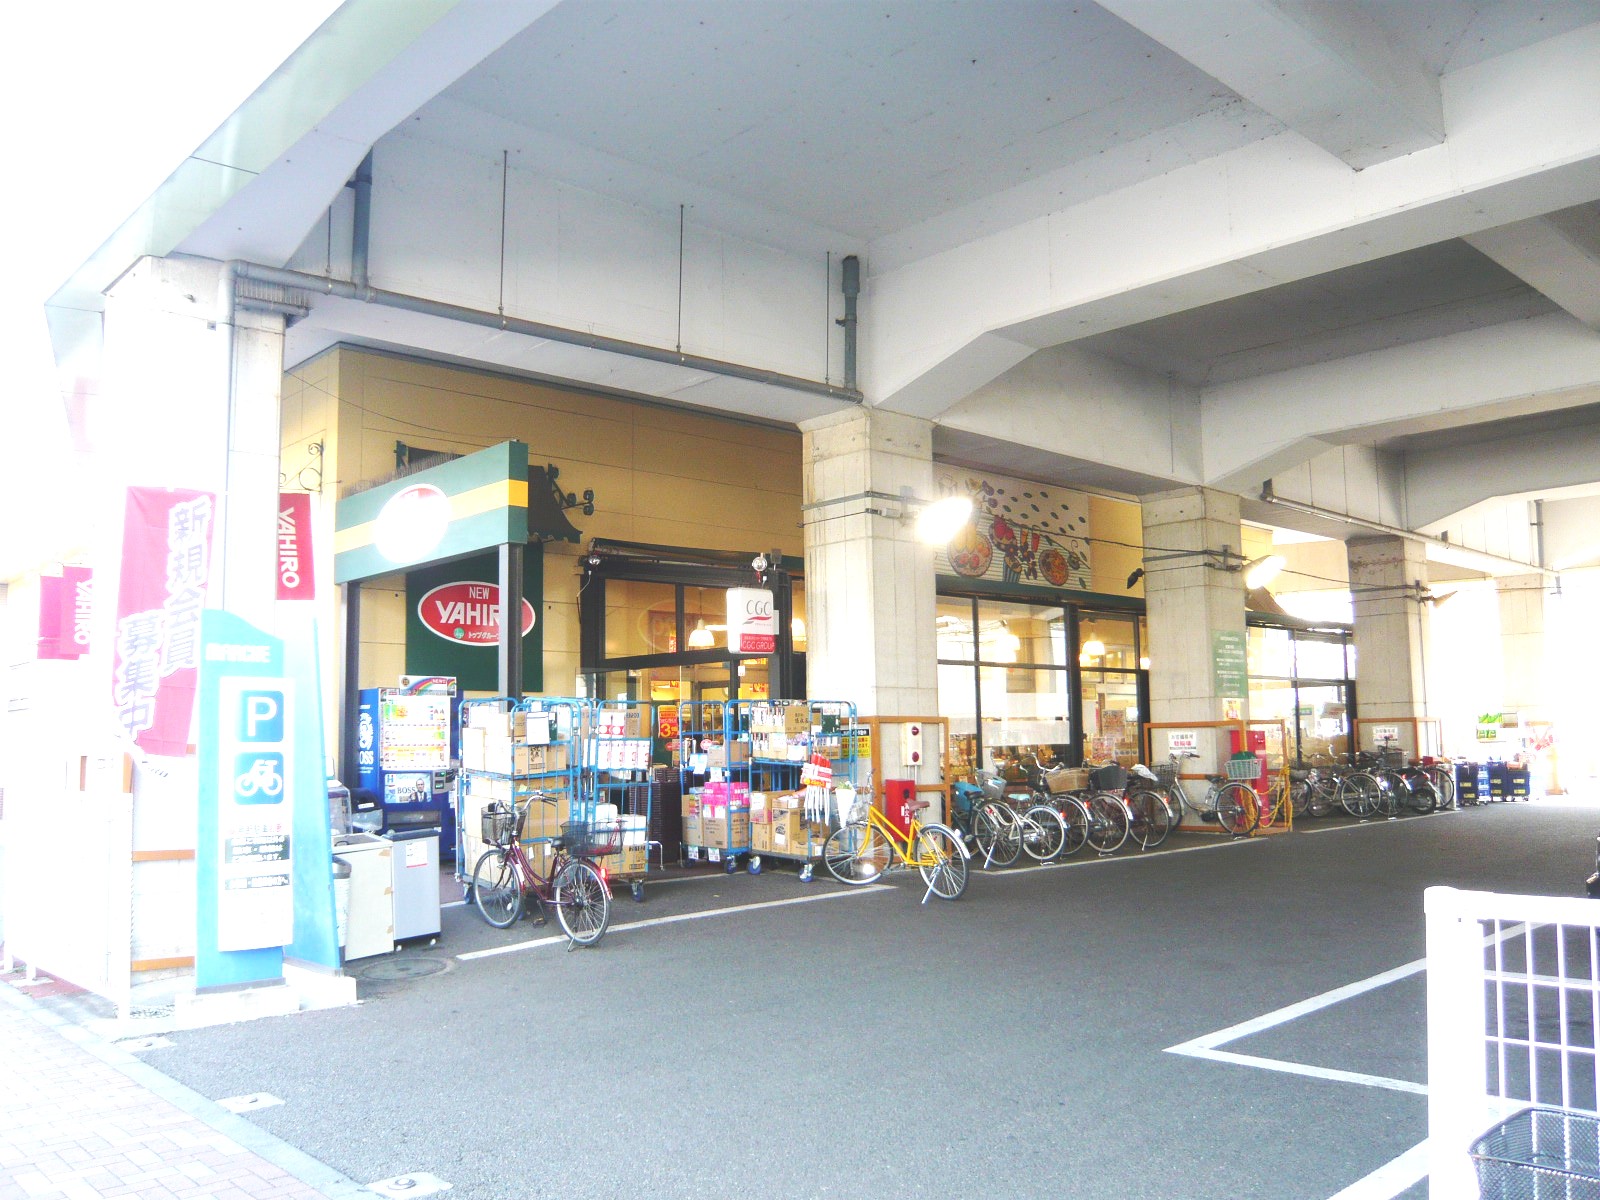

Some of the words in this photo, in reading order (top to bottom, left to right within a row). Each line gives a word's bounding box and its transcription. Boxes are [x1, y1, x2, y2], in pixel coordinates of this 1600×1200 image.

[278, 506, 300, 588] YAHIRO
[163, 498, 209, 674] 新規会員
[469, 586, 490, 600] NEW
[74, 579, 93, 645] YAHIRO
[435, 600, 499, 626] YAHIR
[746, 599, 771, 616] CGC
[468, 631, 499, 640] トップグルー
[118, 613, 159, 736] 募集中
[247, 696, 278, 737] P
[359, 750, 374, 765] OSS
